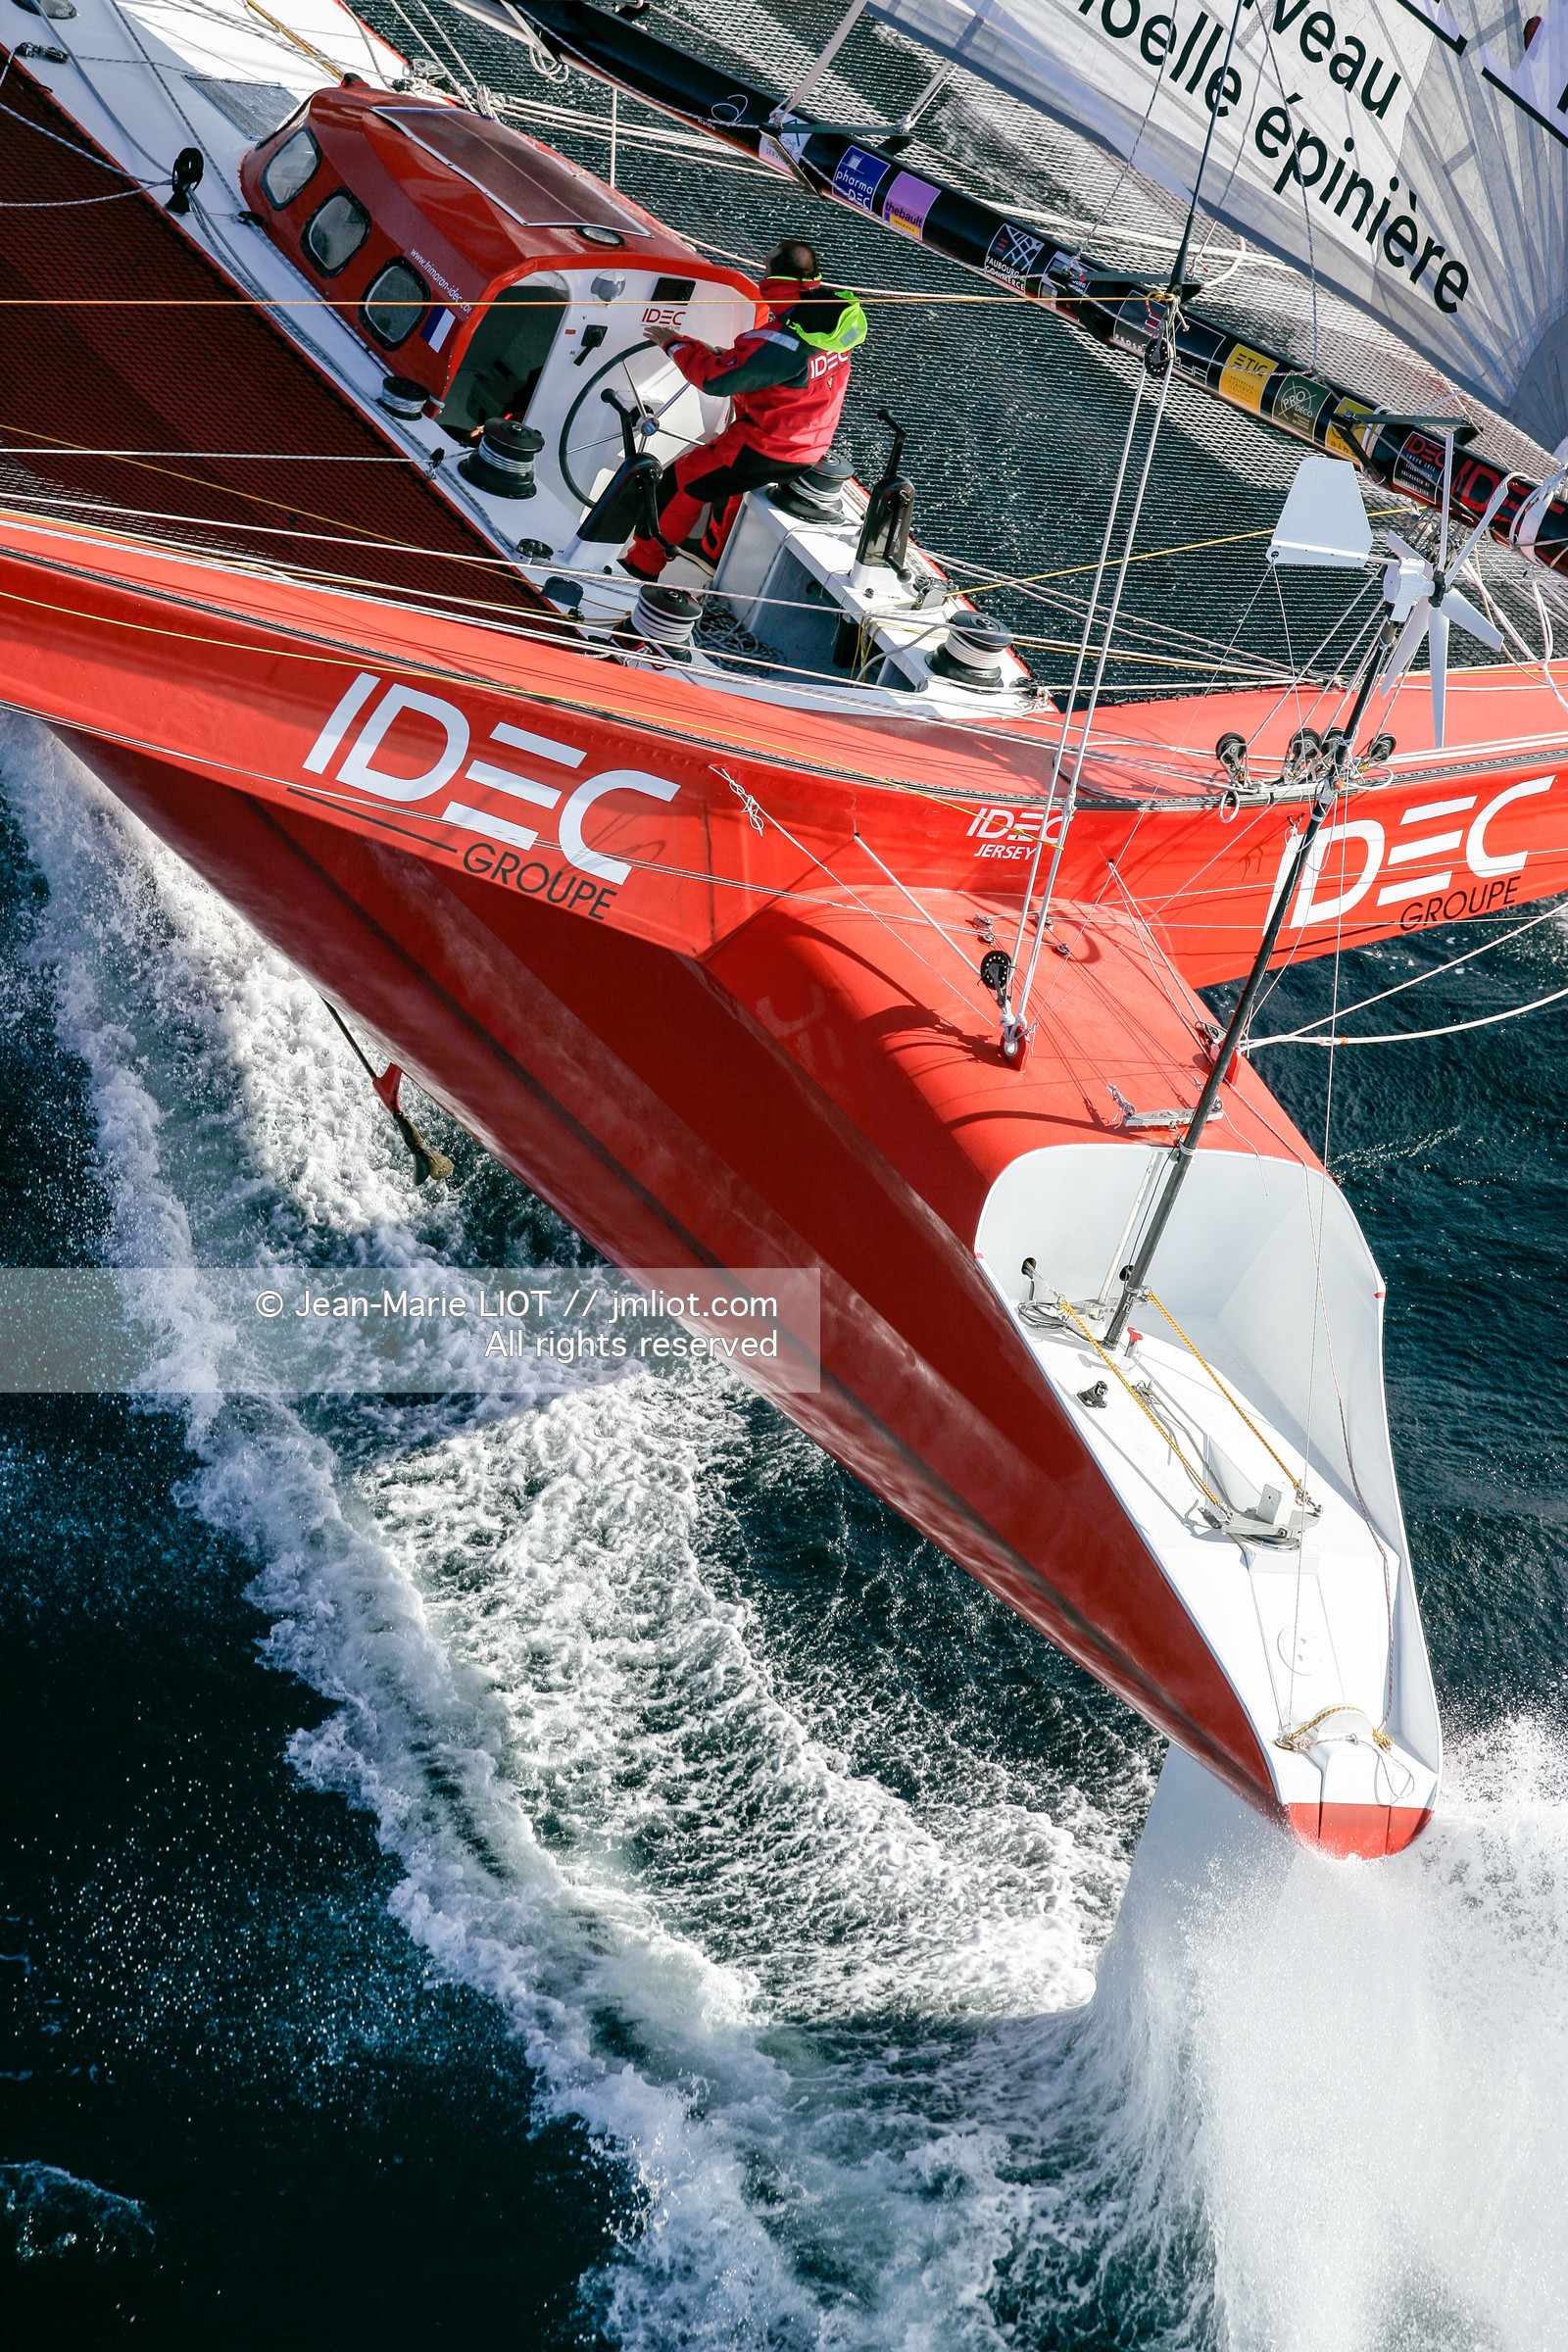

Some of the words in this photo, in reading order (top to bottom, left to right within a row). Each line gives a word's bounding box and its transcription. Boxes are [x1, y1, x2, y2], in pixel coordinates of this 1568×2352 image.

[1243, 0, 1401, 120] veau
[1078, 0, 1243, 118] oelle
[1254, 92, 1469, 315] épinière
[836, 170, 874, 196] pharma
[885, 201, 922, 228] thebault
[986, 256, 1020, 277] FAUBOURG
[642, 308, 686, 325] IDEC
[810, 351, 850, 380] IDEC
[1233, 353, 1269, 377] ETIC
[1282, 390, 1306, 410] PRO
[1404, 434, 1446, 468] IDEC
[302, 671, 681, 886] IDEC
[966, 808, 1075, 844] IDEC
[973, 843, 1038, 860] JERSEY
[1262, 774, 1557, 937] IDEC
[463, 842, 617, 920] GROUPE
[1399, 876, 1521, 932] GROUPE
